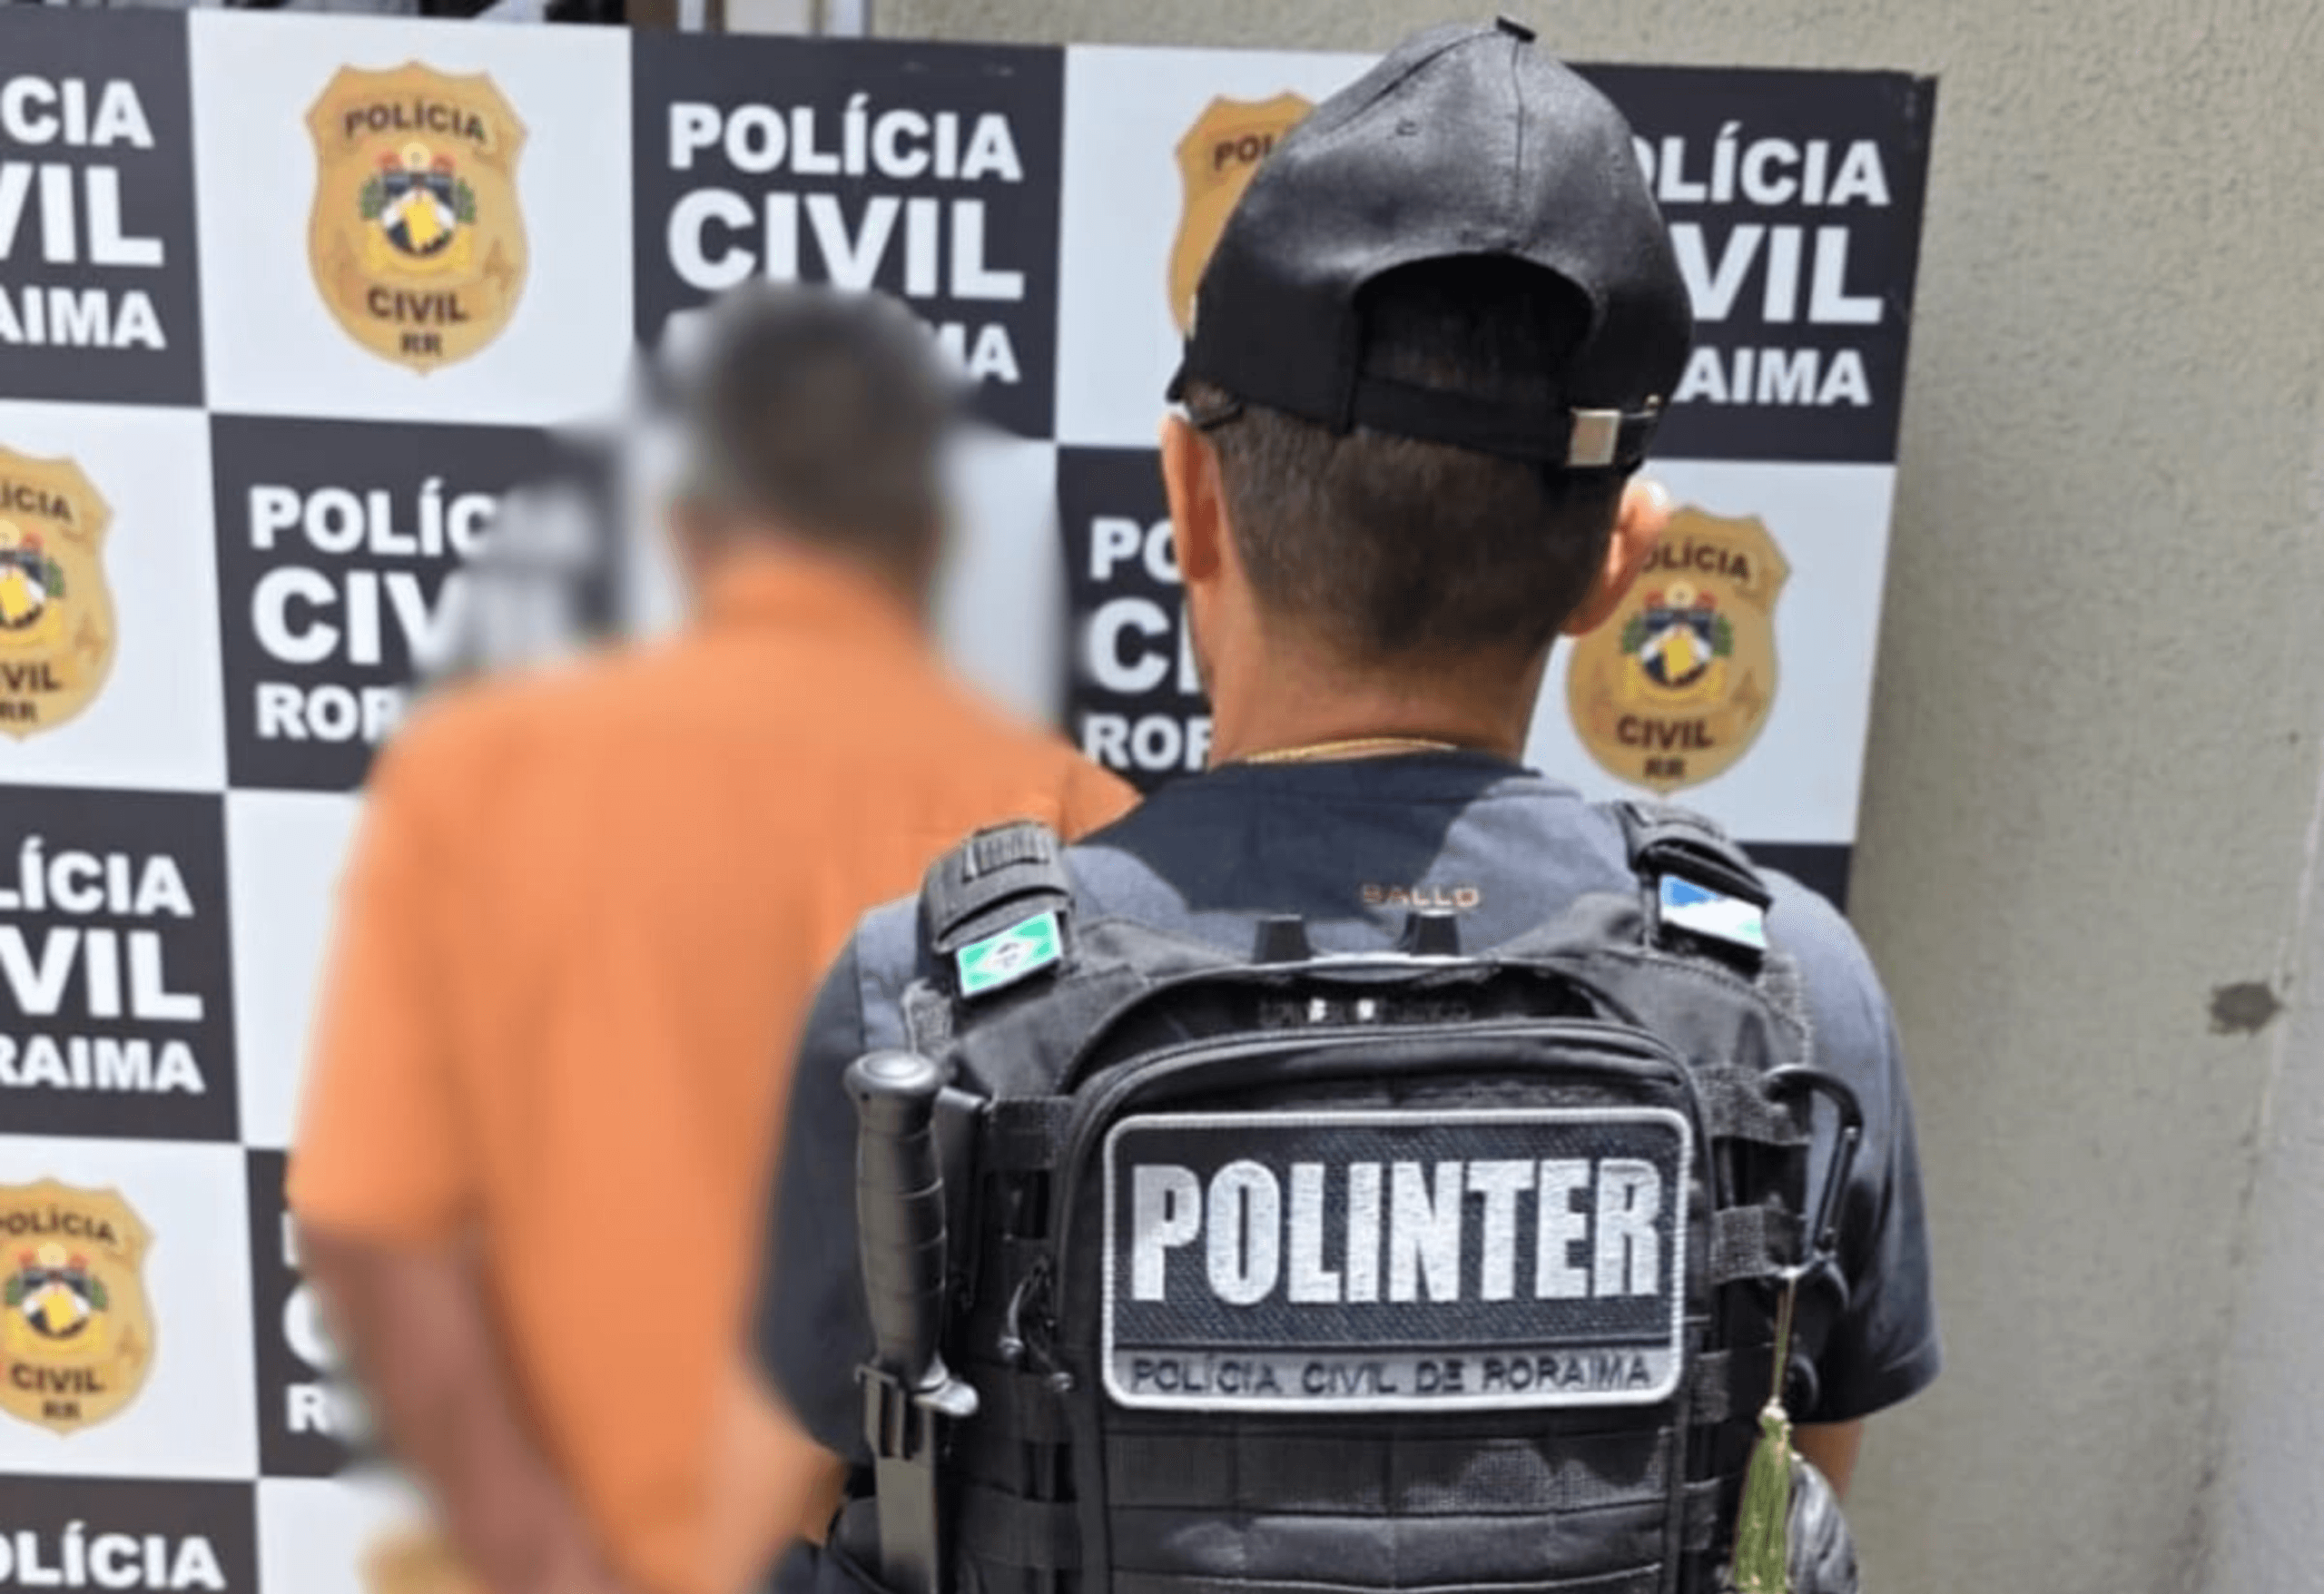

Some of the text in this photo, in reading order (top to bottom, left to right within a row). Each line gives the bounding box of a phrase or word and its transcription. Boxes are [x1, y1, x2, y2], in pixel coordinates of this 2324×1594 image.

[344, 95, 486, 143] POLÍCIA
[668, 92, 1023, 182] POLÍCIA
[666, 187, 1024, 300] CIVIL
[1669, 223, 1883, 323] VIL
[367, 284, 470, 324] CIVIL
[401, 332, 442, 357] RR
[1672, 347, 1870, 405] AIMA
[1617, 715, 1714, 751] CIVIL
[1643, 758, 1685, 779] RR
[1131, 1157, 1663, 1305] POLINTER
[11, 1362, 107, 1393] CIVIL
[1303, 1361, 1398, 1394] CIVIL
[1415, 1360, 1463, 1392] DE
[1482, 1351, 1651, 1392] RORAIMA
